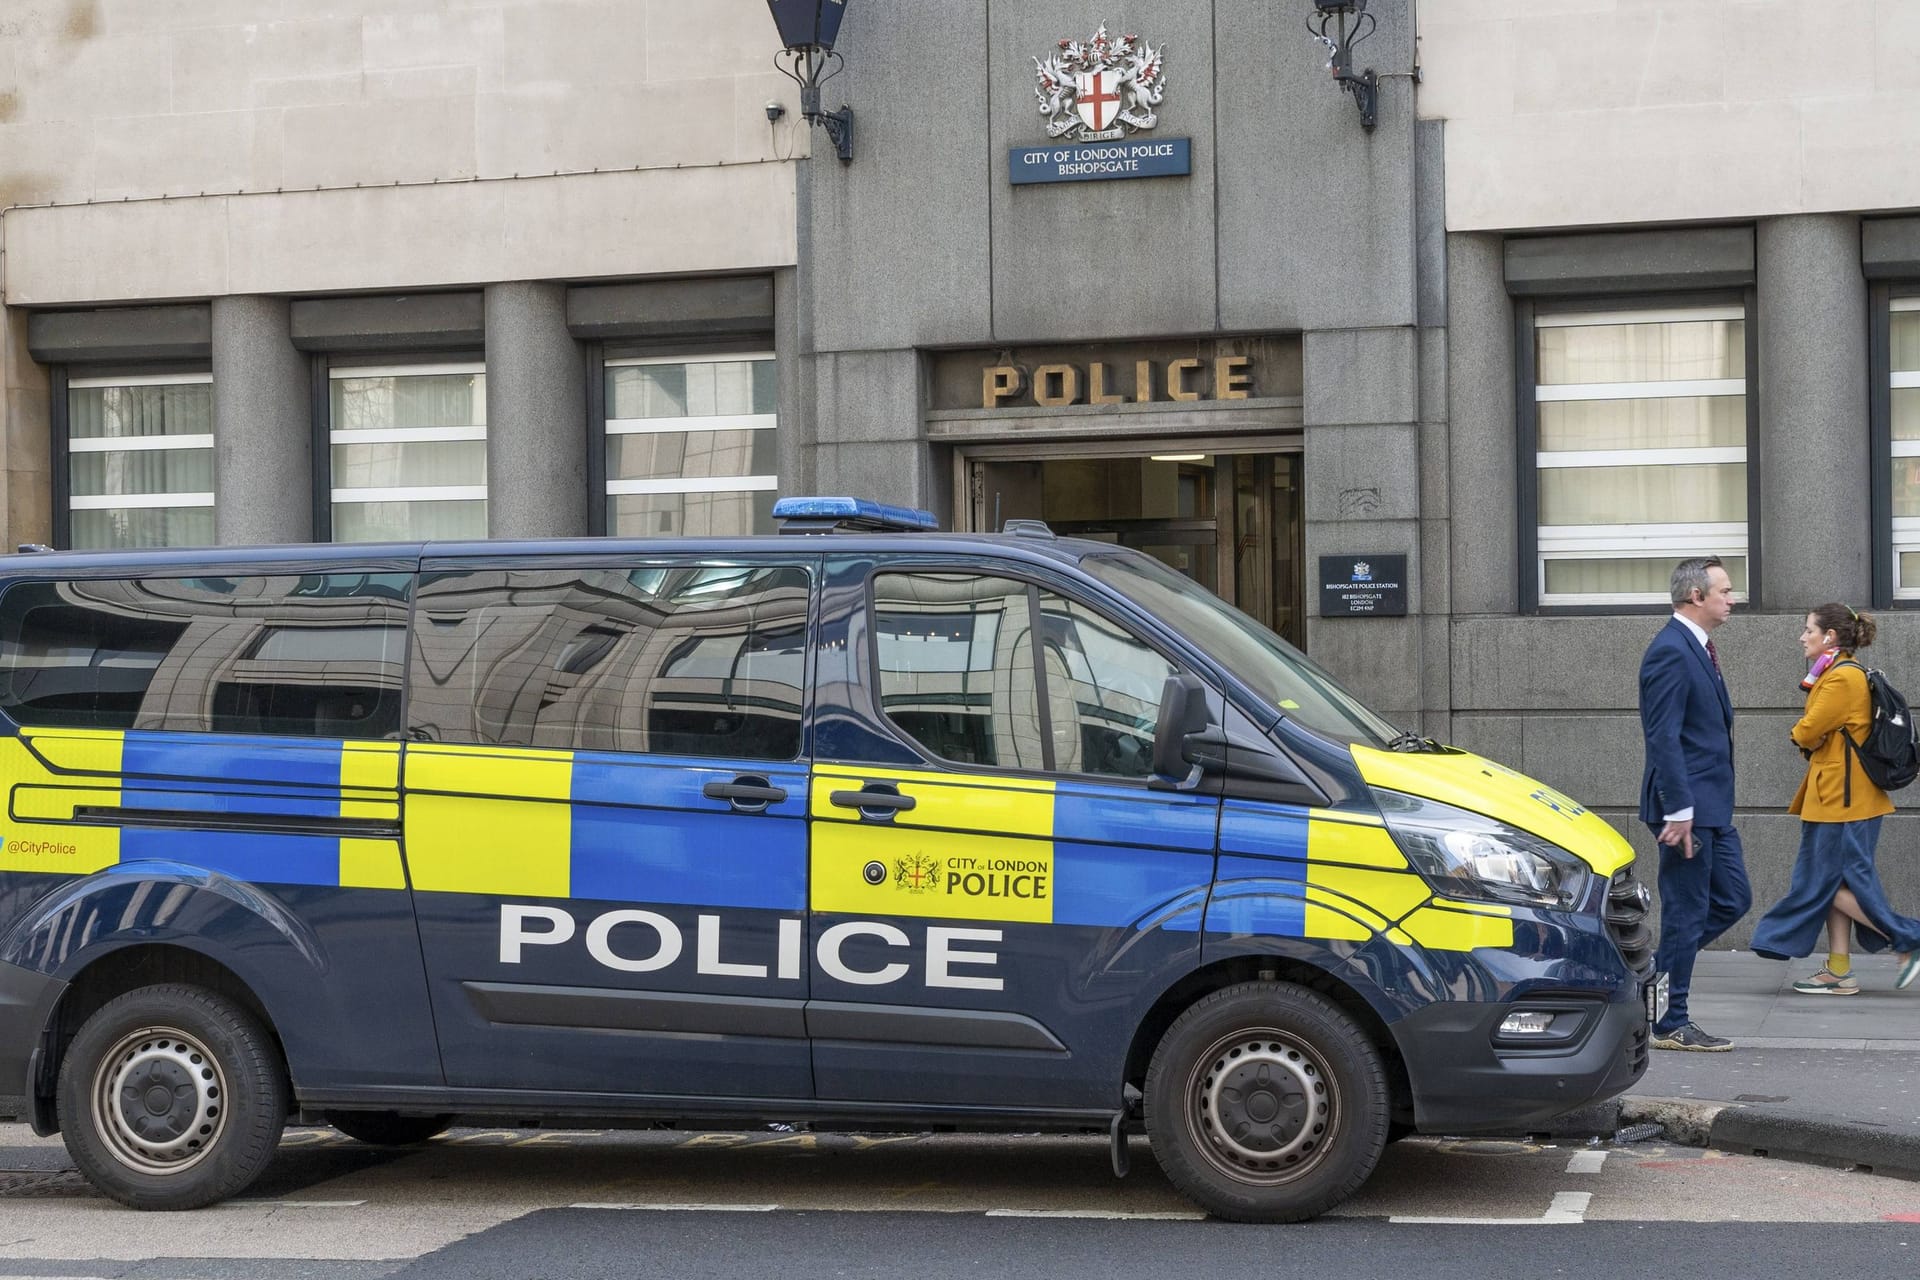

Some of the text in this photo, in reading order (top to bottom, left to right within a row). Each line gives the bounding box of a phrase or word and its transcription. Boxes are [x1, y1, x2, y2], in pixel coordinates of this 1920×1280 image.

[1024, 144, 1173, 165] CITY OF LONDON POLICE
[1058, 160, 1138, 175] BISHOPSGATE
[983, 356, 1255, 408] POLICE
[8, 840, 76, 855] @CityPolice
[947, 858, 977, 870] CITY
[988, 860, 1048, 873] LONDON
[946, 872, 1047, 899] POLICE
[499, 904, 1004, 991] POLICE
